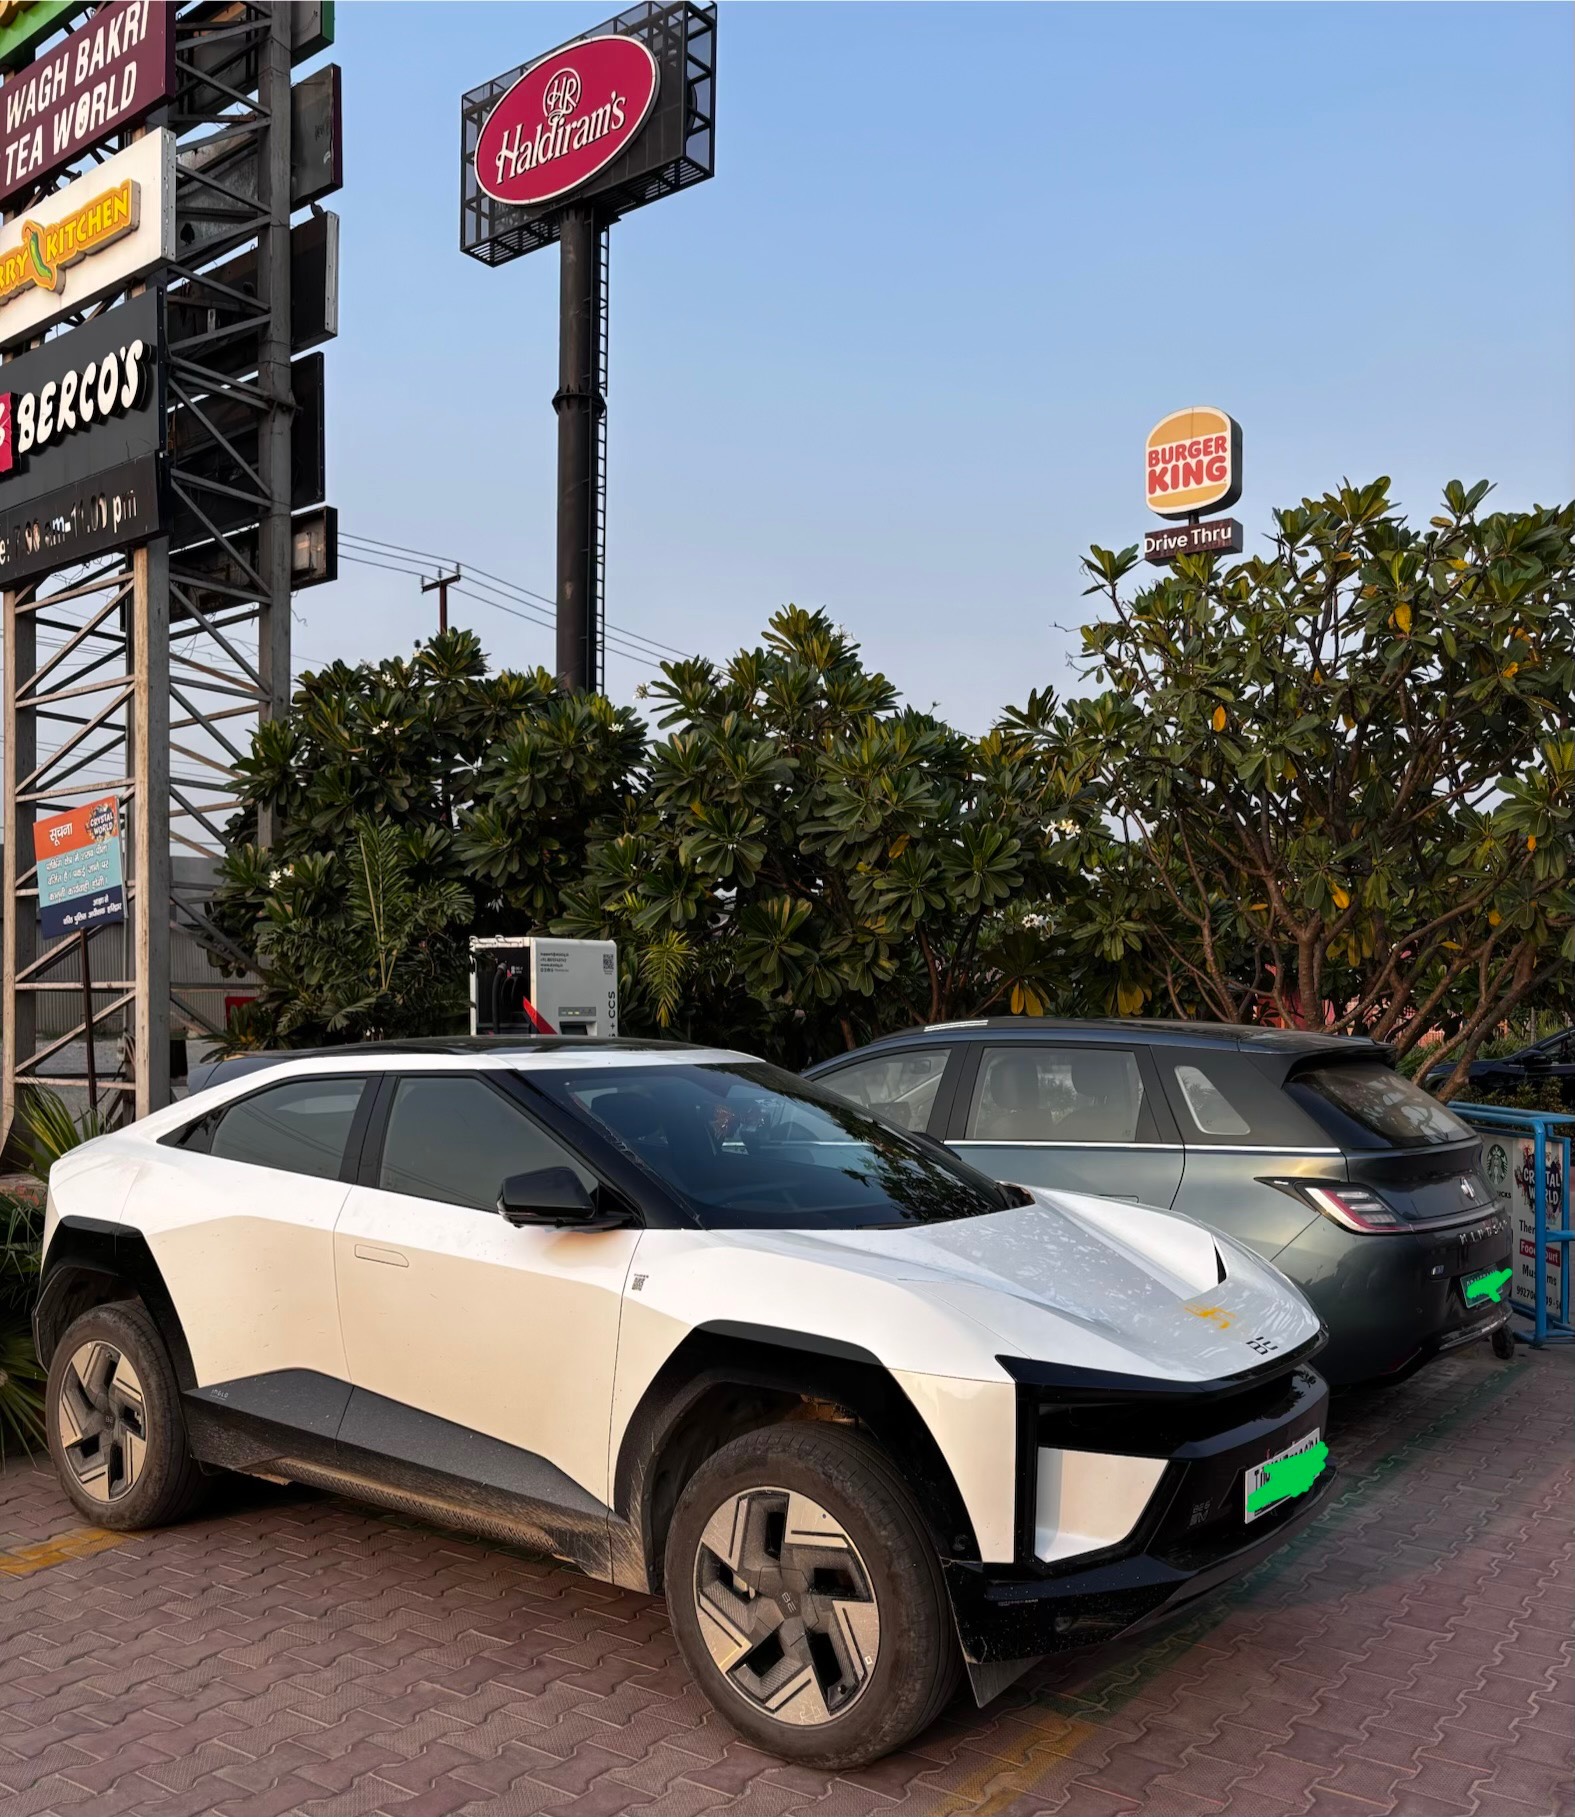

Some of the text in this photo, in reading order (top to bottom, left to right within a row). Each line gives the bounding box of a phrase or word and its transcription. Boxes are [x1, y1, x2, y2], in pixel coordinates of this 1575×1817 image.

[6, 0, 150, 134] WAGH BAKRI
[5, 61, 138, 187] TEA WORLD
[495, 91, 626, 185] Haldiram's
[46, 188, 129, 262] KITCHEN
[17, 339, 144, 454] BERCO'S
[1148, 435, 1228, 469] BURGER
[1148, 455, 1228, 496] KING
[1144, 525, 1232, 554] Drive Thru
[49, 822, 73, 847] सूचना
[90, 812, 114, 827] CRYSTAL
[93, 822, 113, 835] WORLD
[608, 991, 616, 1019] CCS
[1523, 1167, 1561, 1188] CRTAL
